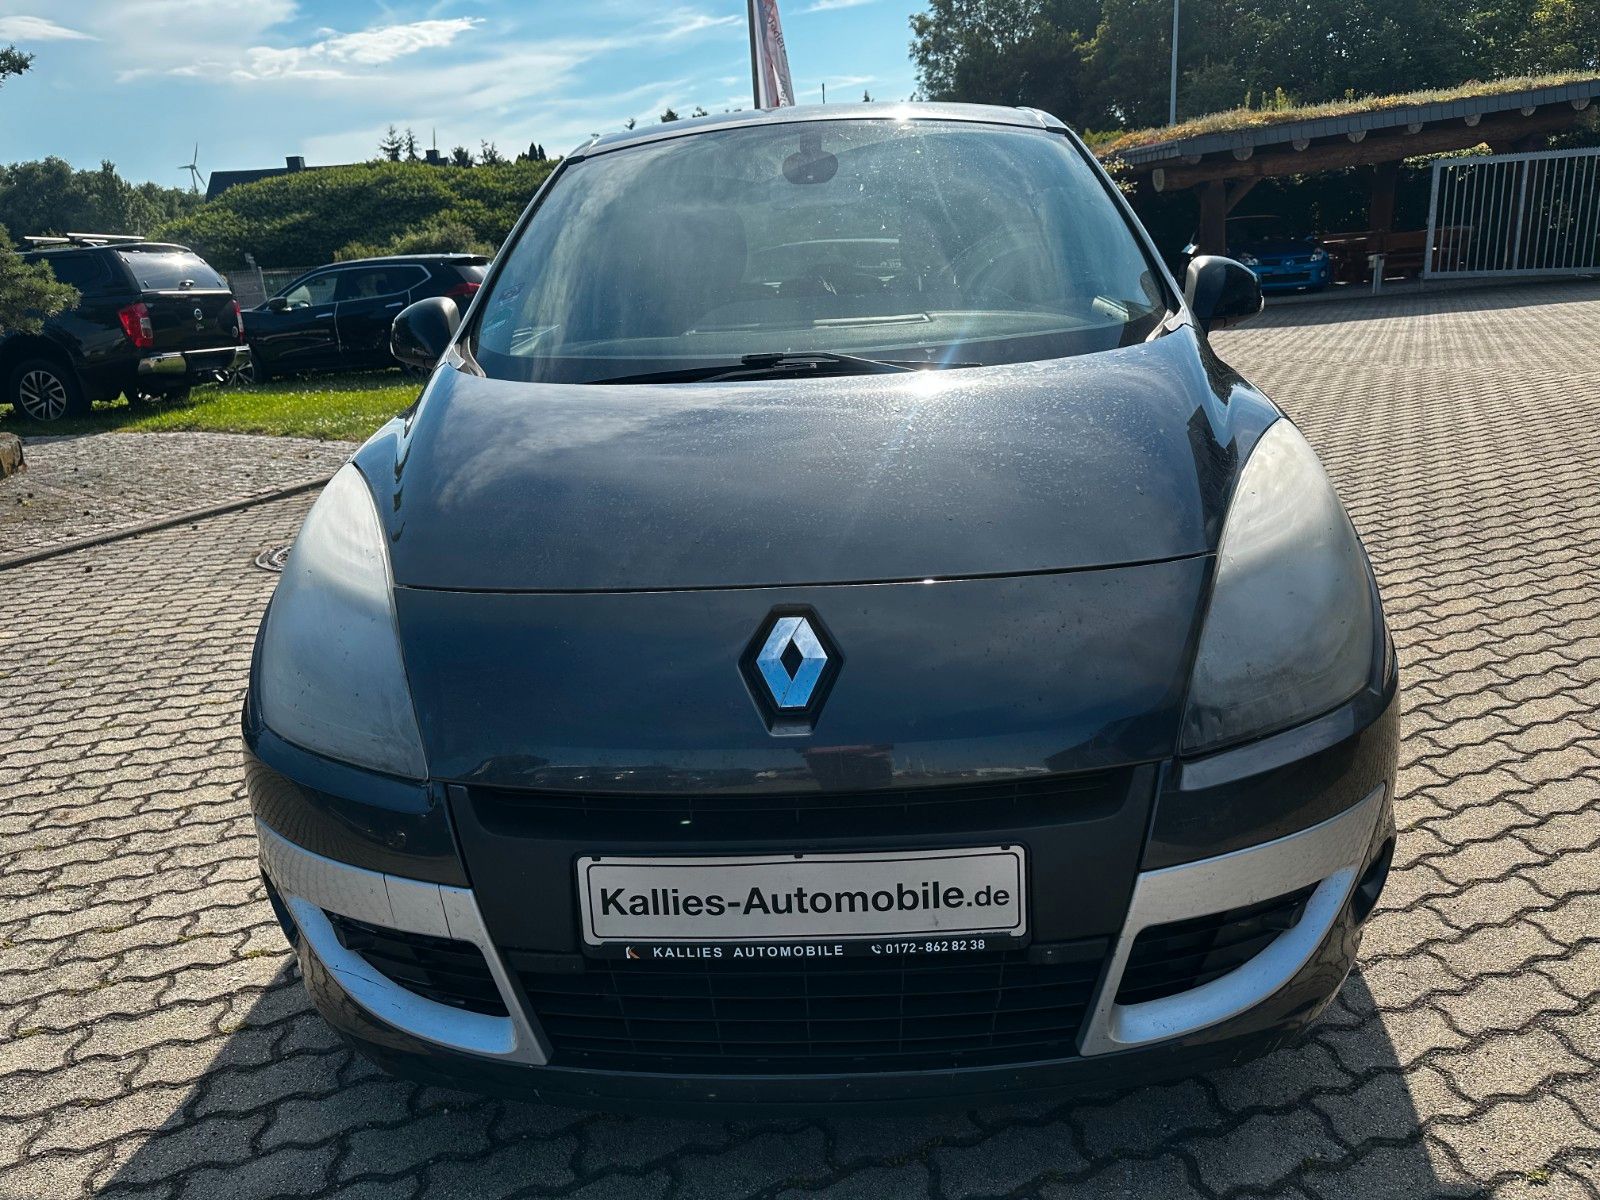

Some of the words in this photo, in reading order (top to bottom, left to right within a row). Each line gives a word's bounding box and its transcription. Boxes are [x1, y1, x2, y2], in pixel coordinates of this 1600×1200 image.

[600, 881, 1010, 916] Kallies-Automobile.de
[653, 946, 723, 958] KALLIES
[733, 944, 844, 958] AUTOMOBILE
[885, 941, 949, 954] 0172-862
[951, 939, 967, 951] 82
[970, 939, 986, 950] 38
